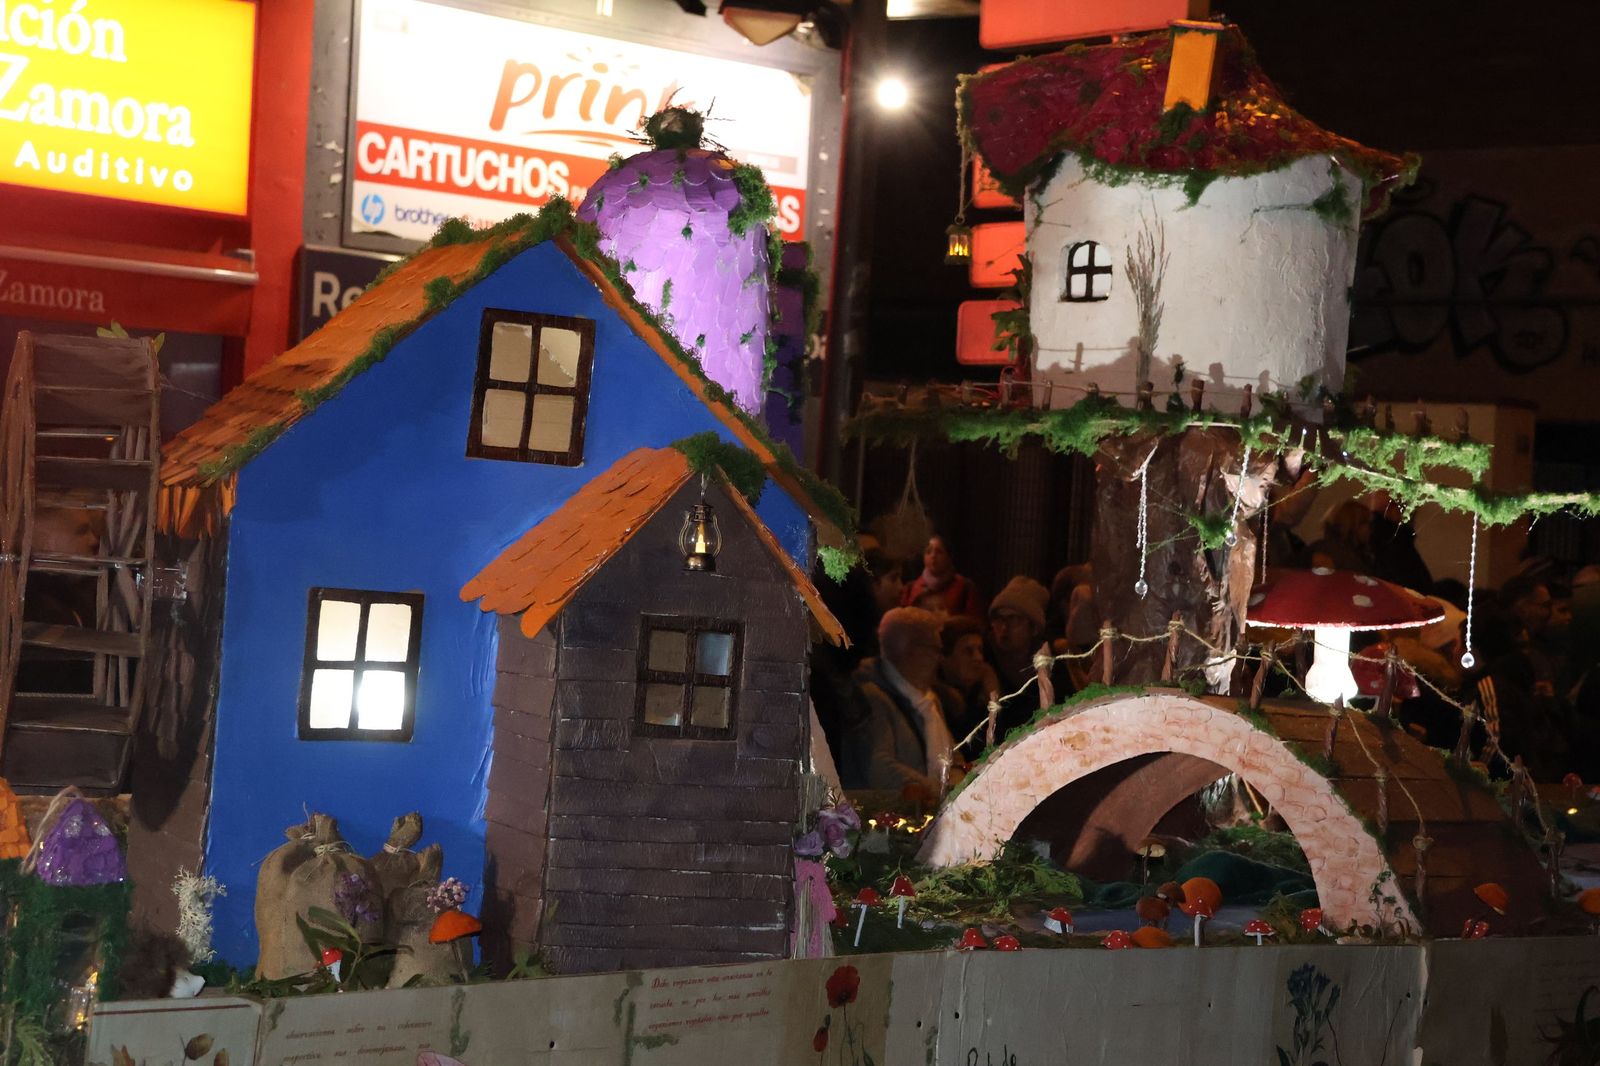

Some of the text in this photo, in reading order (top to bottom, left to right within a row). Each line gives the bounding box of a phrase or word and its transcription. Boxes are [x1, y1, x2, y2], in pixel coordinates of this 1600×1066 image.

[0, 0, 126, 62] ción
[0, 52, 195, 147] Zamora
[14, 139, 193, 191] Auditivo
[358, 131, 569, 199] CARTUCHOS
[0, 269, 105, 313] Zamora
